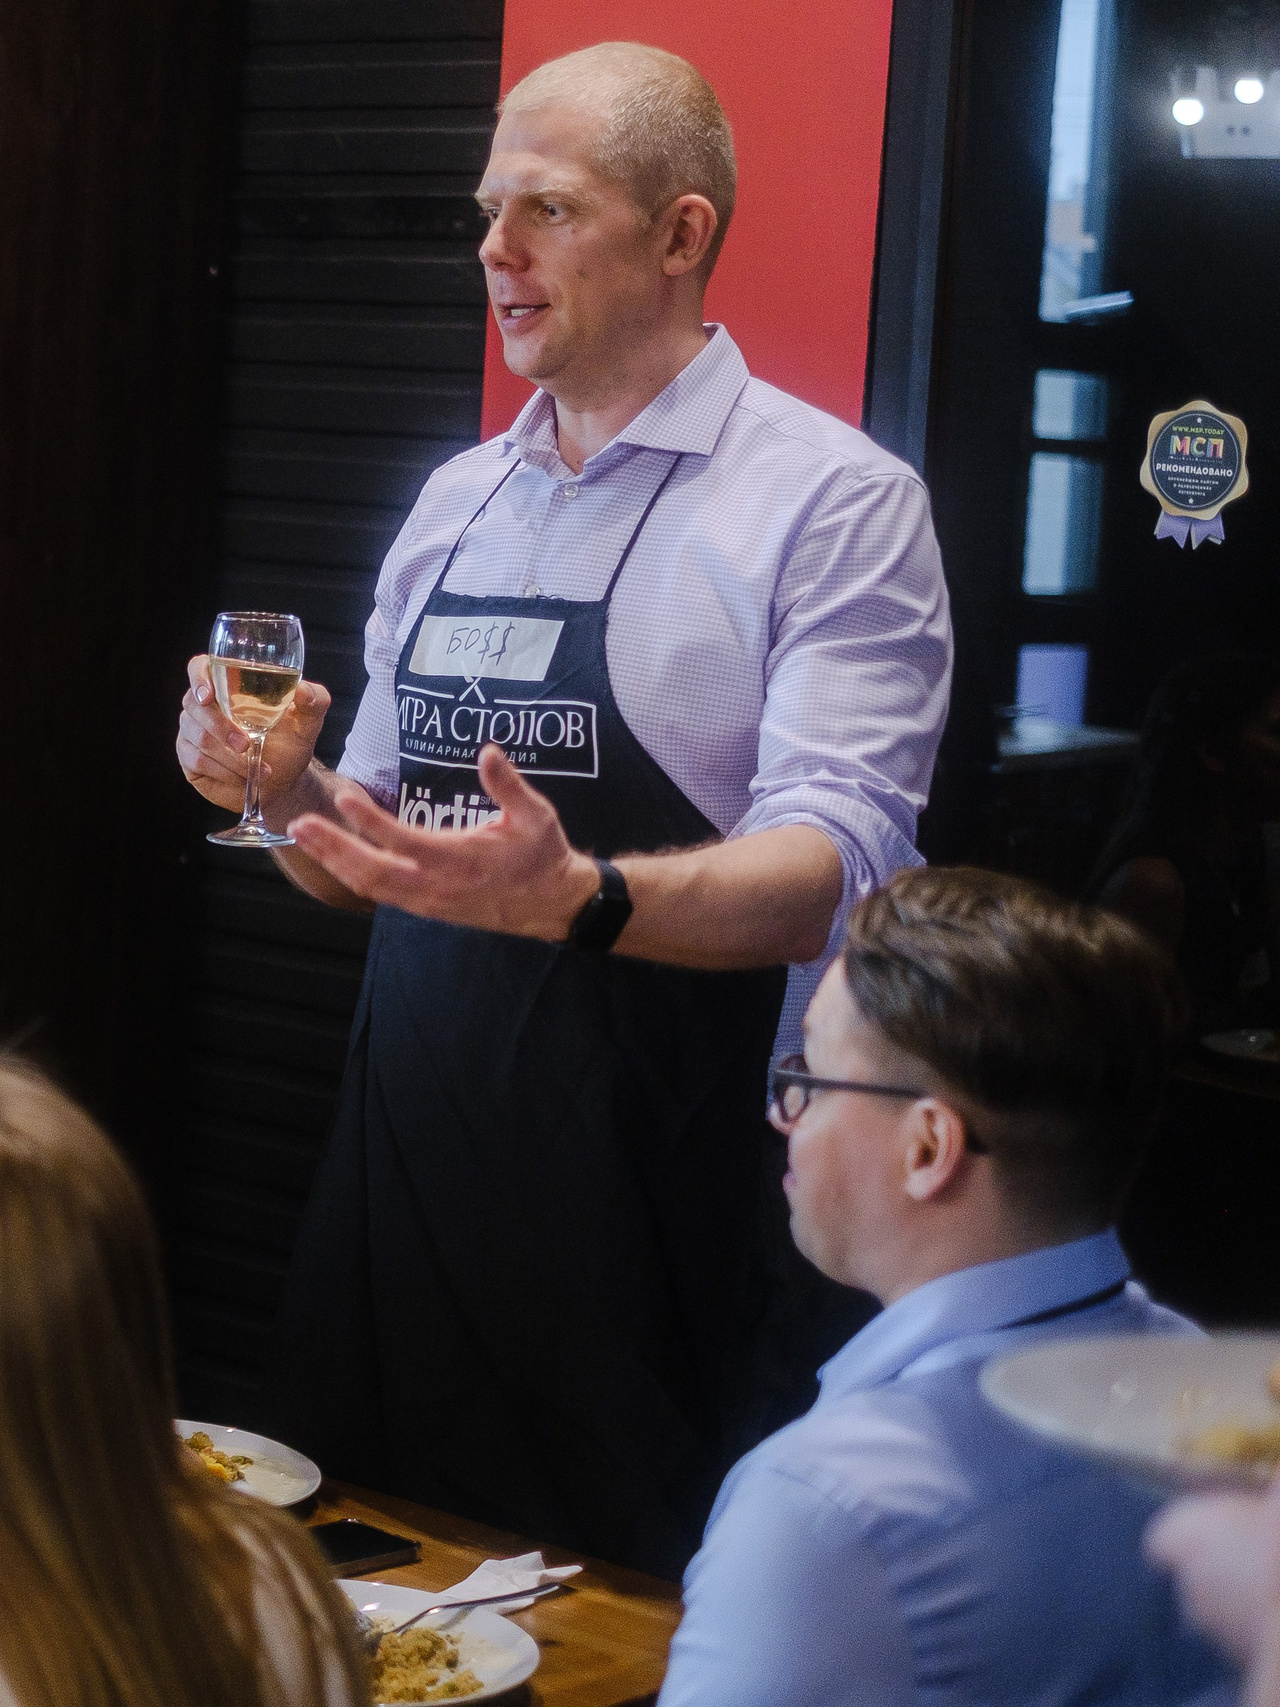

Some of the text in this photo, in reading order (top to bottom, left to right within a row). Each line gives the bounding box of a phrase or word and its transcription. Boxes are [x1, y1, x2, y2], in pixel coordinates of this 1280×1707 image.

[1169, 434, 1224, 459] МСП
[1156, 462, 1233, 477] РЕКОМЕНДОВАНО
[450, 706, 585, 748] СТОЛОВ
